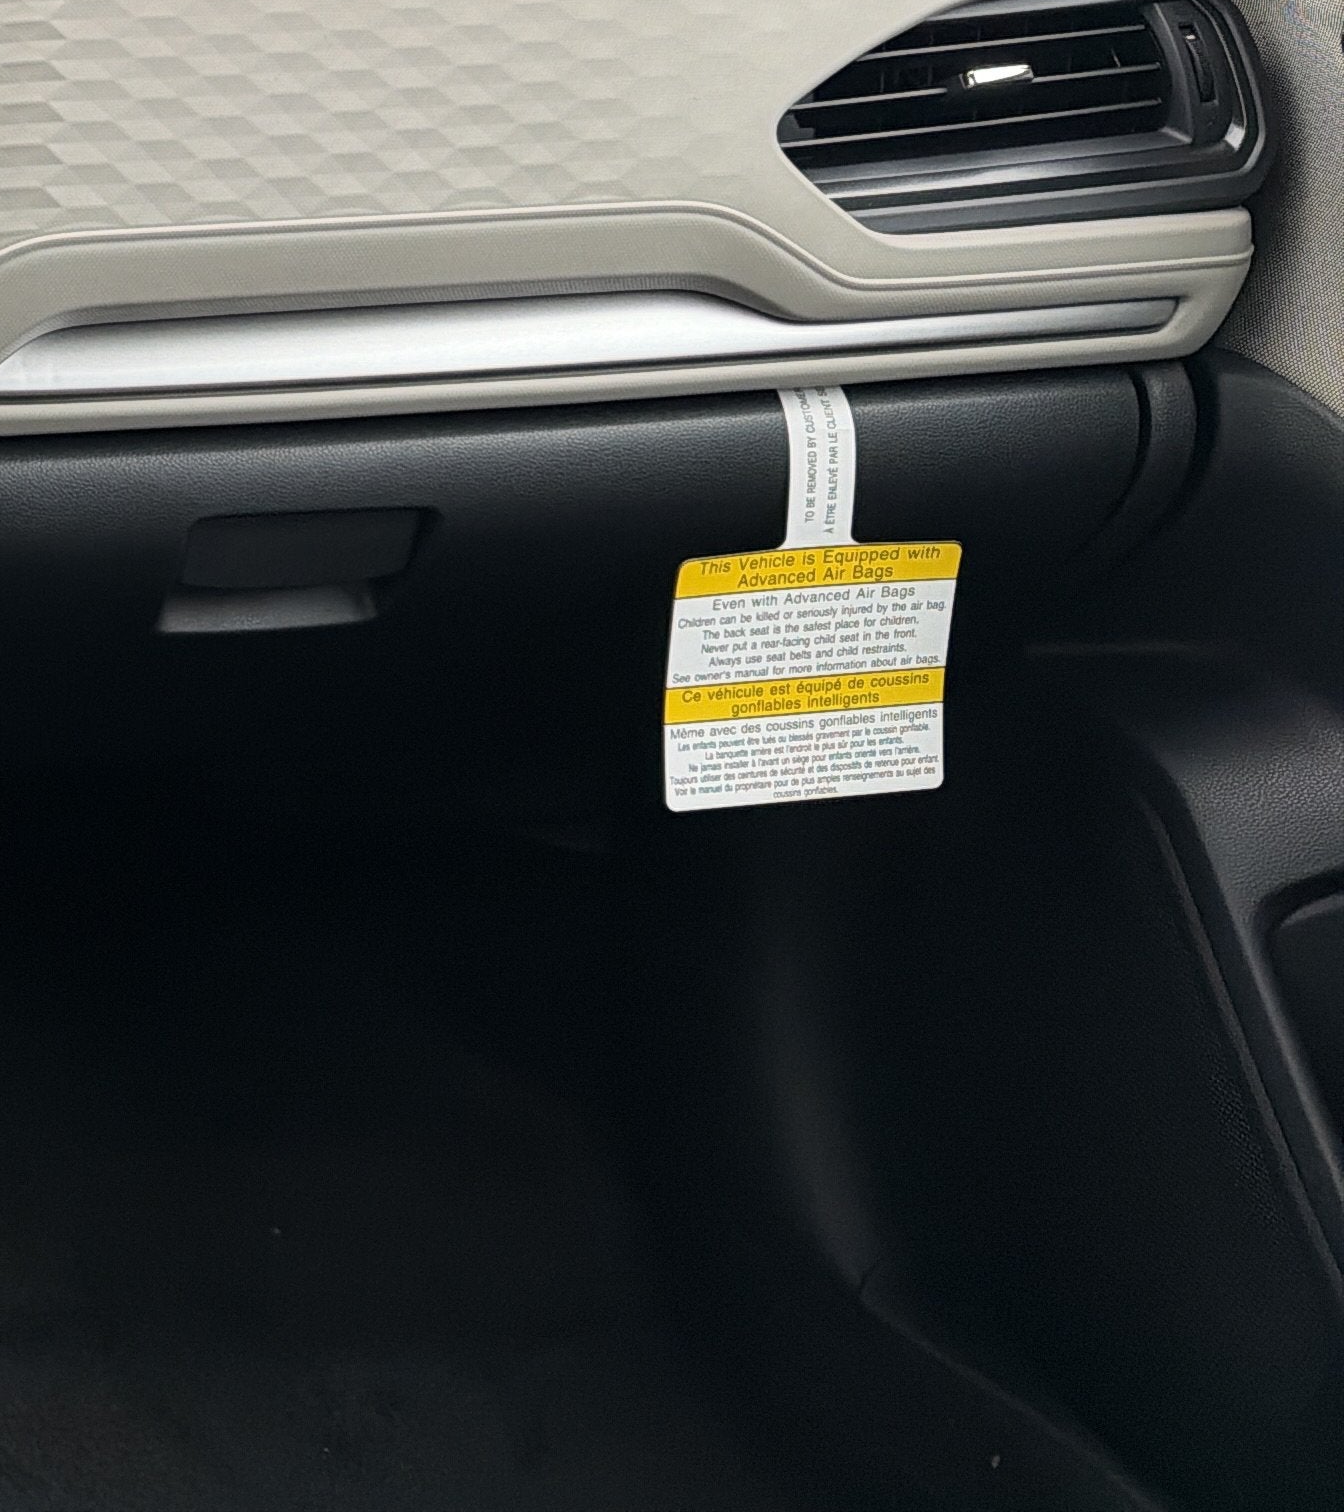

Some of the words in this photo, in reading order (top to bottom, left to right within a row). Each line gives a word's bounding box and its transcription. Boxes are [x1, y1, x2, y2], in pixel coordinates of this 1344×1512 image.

[700, 561, 731, 575] This
[739, 554, 794, 570] Vehicle
[803, 552, 815, 565] is
[823, 547, 900, 566] Equipped
[908, 546, 940, 559] with
[737, 568, 816, 588] Advanced
[823, 568, 845, 581] Air
[853, 565, 893, 581] Bags
[712, 599, 746, 611] Even
[752, 595, 777, 608] with
[784, 589, 850, 605] Advanced
[856, 588, 875, 599] Air
[881, 586, 915, 599] Bags
[682, 690, 701, 703] Ce
[707, 686, 763, 700] véhicule
[770, 683, 791, 695] est
[797, 678, 841, 695] équipé
[848, 677, 864, 689] de
[870, 673, 929, 688] coussins
[732, 698, 801, 717] gonflables
[807, 692, 879, 708] intelligents
